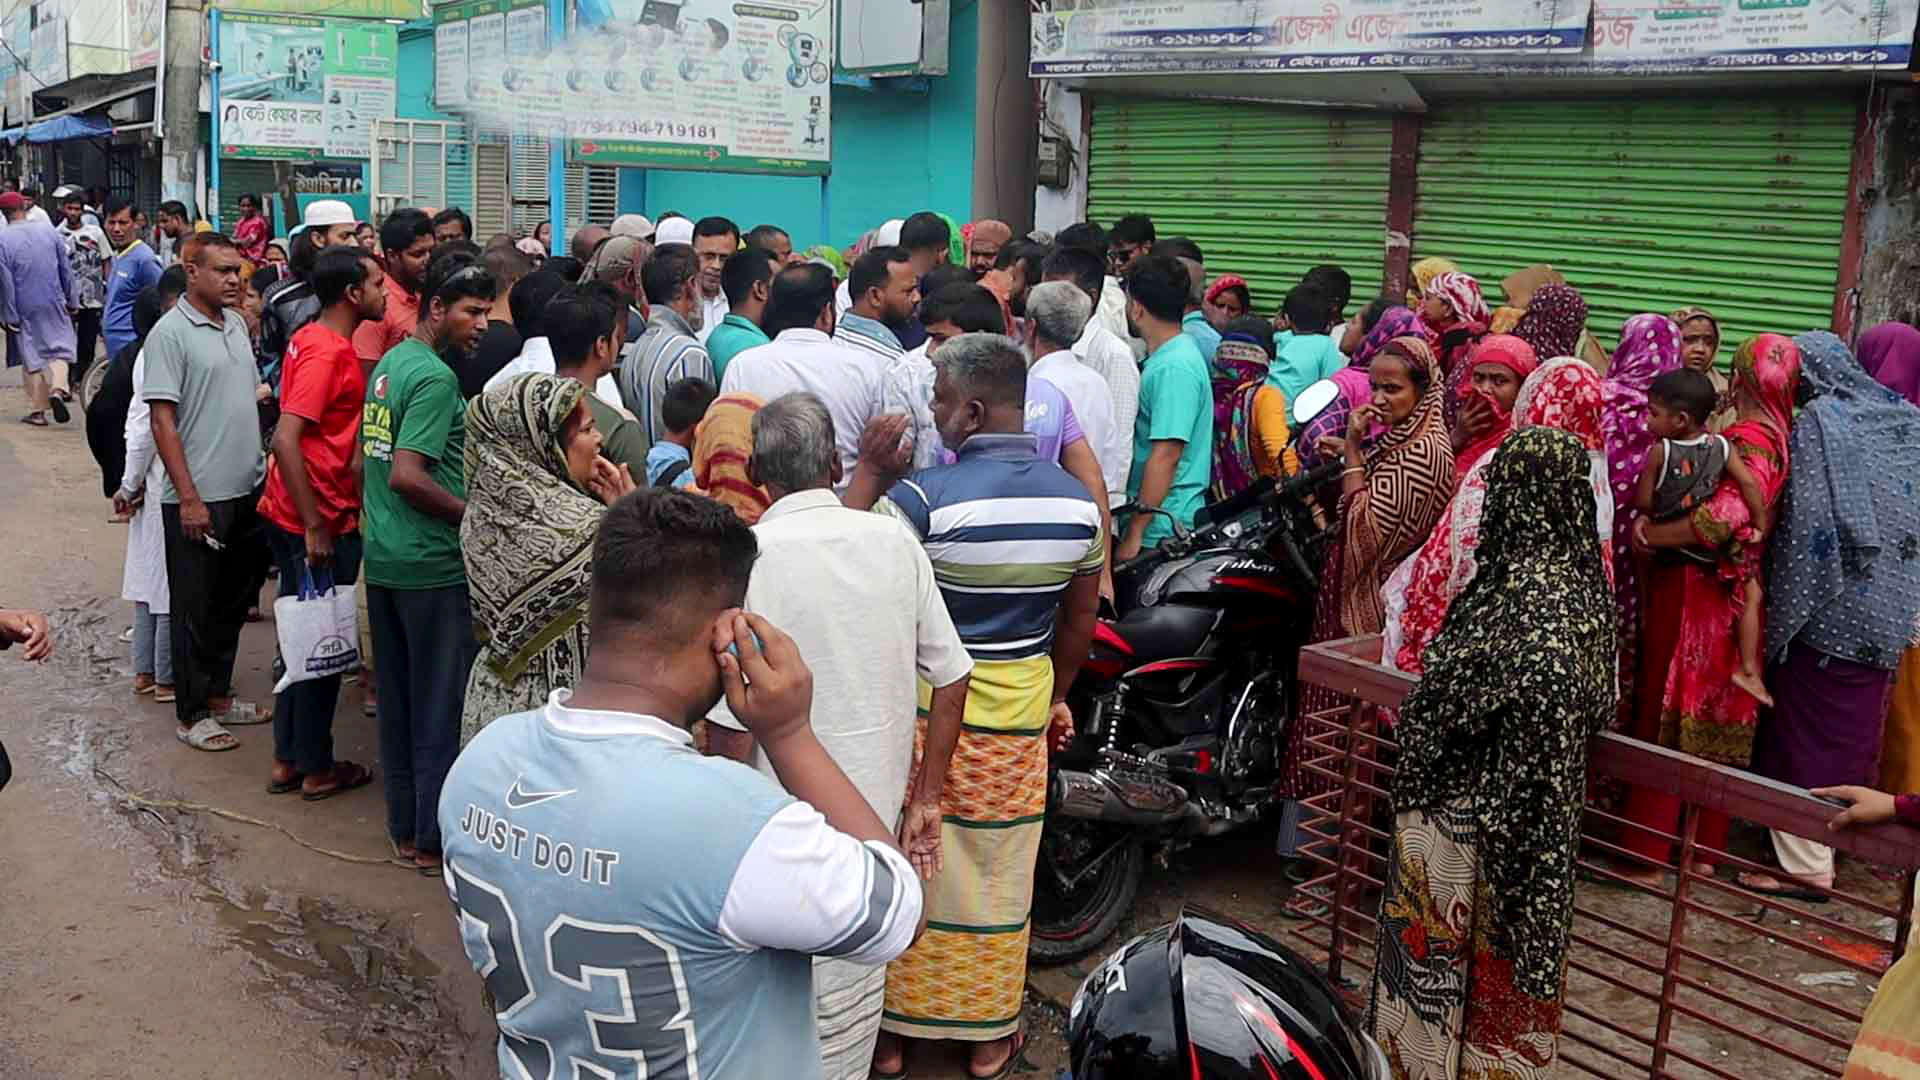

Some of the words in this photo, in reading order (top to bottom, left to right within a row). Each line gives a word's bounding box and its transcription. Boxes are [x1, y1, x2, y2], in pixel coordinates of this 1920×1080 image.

[460, 803, 530, 861] JUST
[532, 833, 576, 877] DO
[580, 847, 621, 885] IT
[445, 857, 699, 1080] 23
